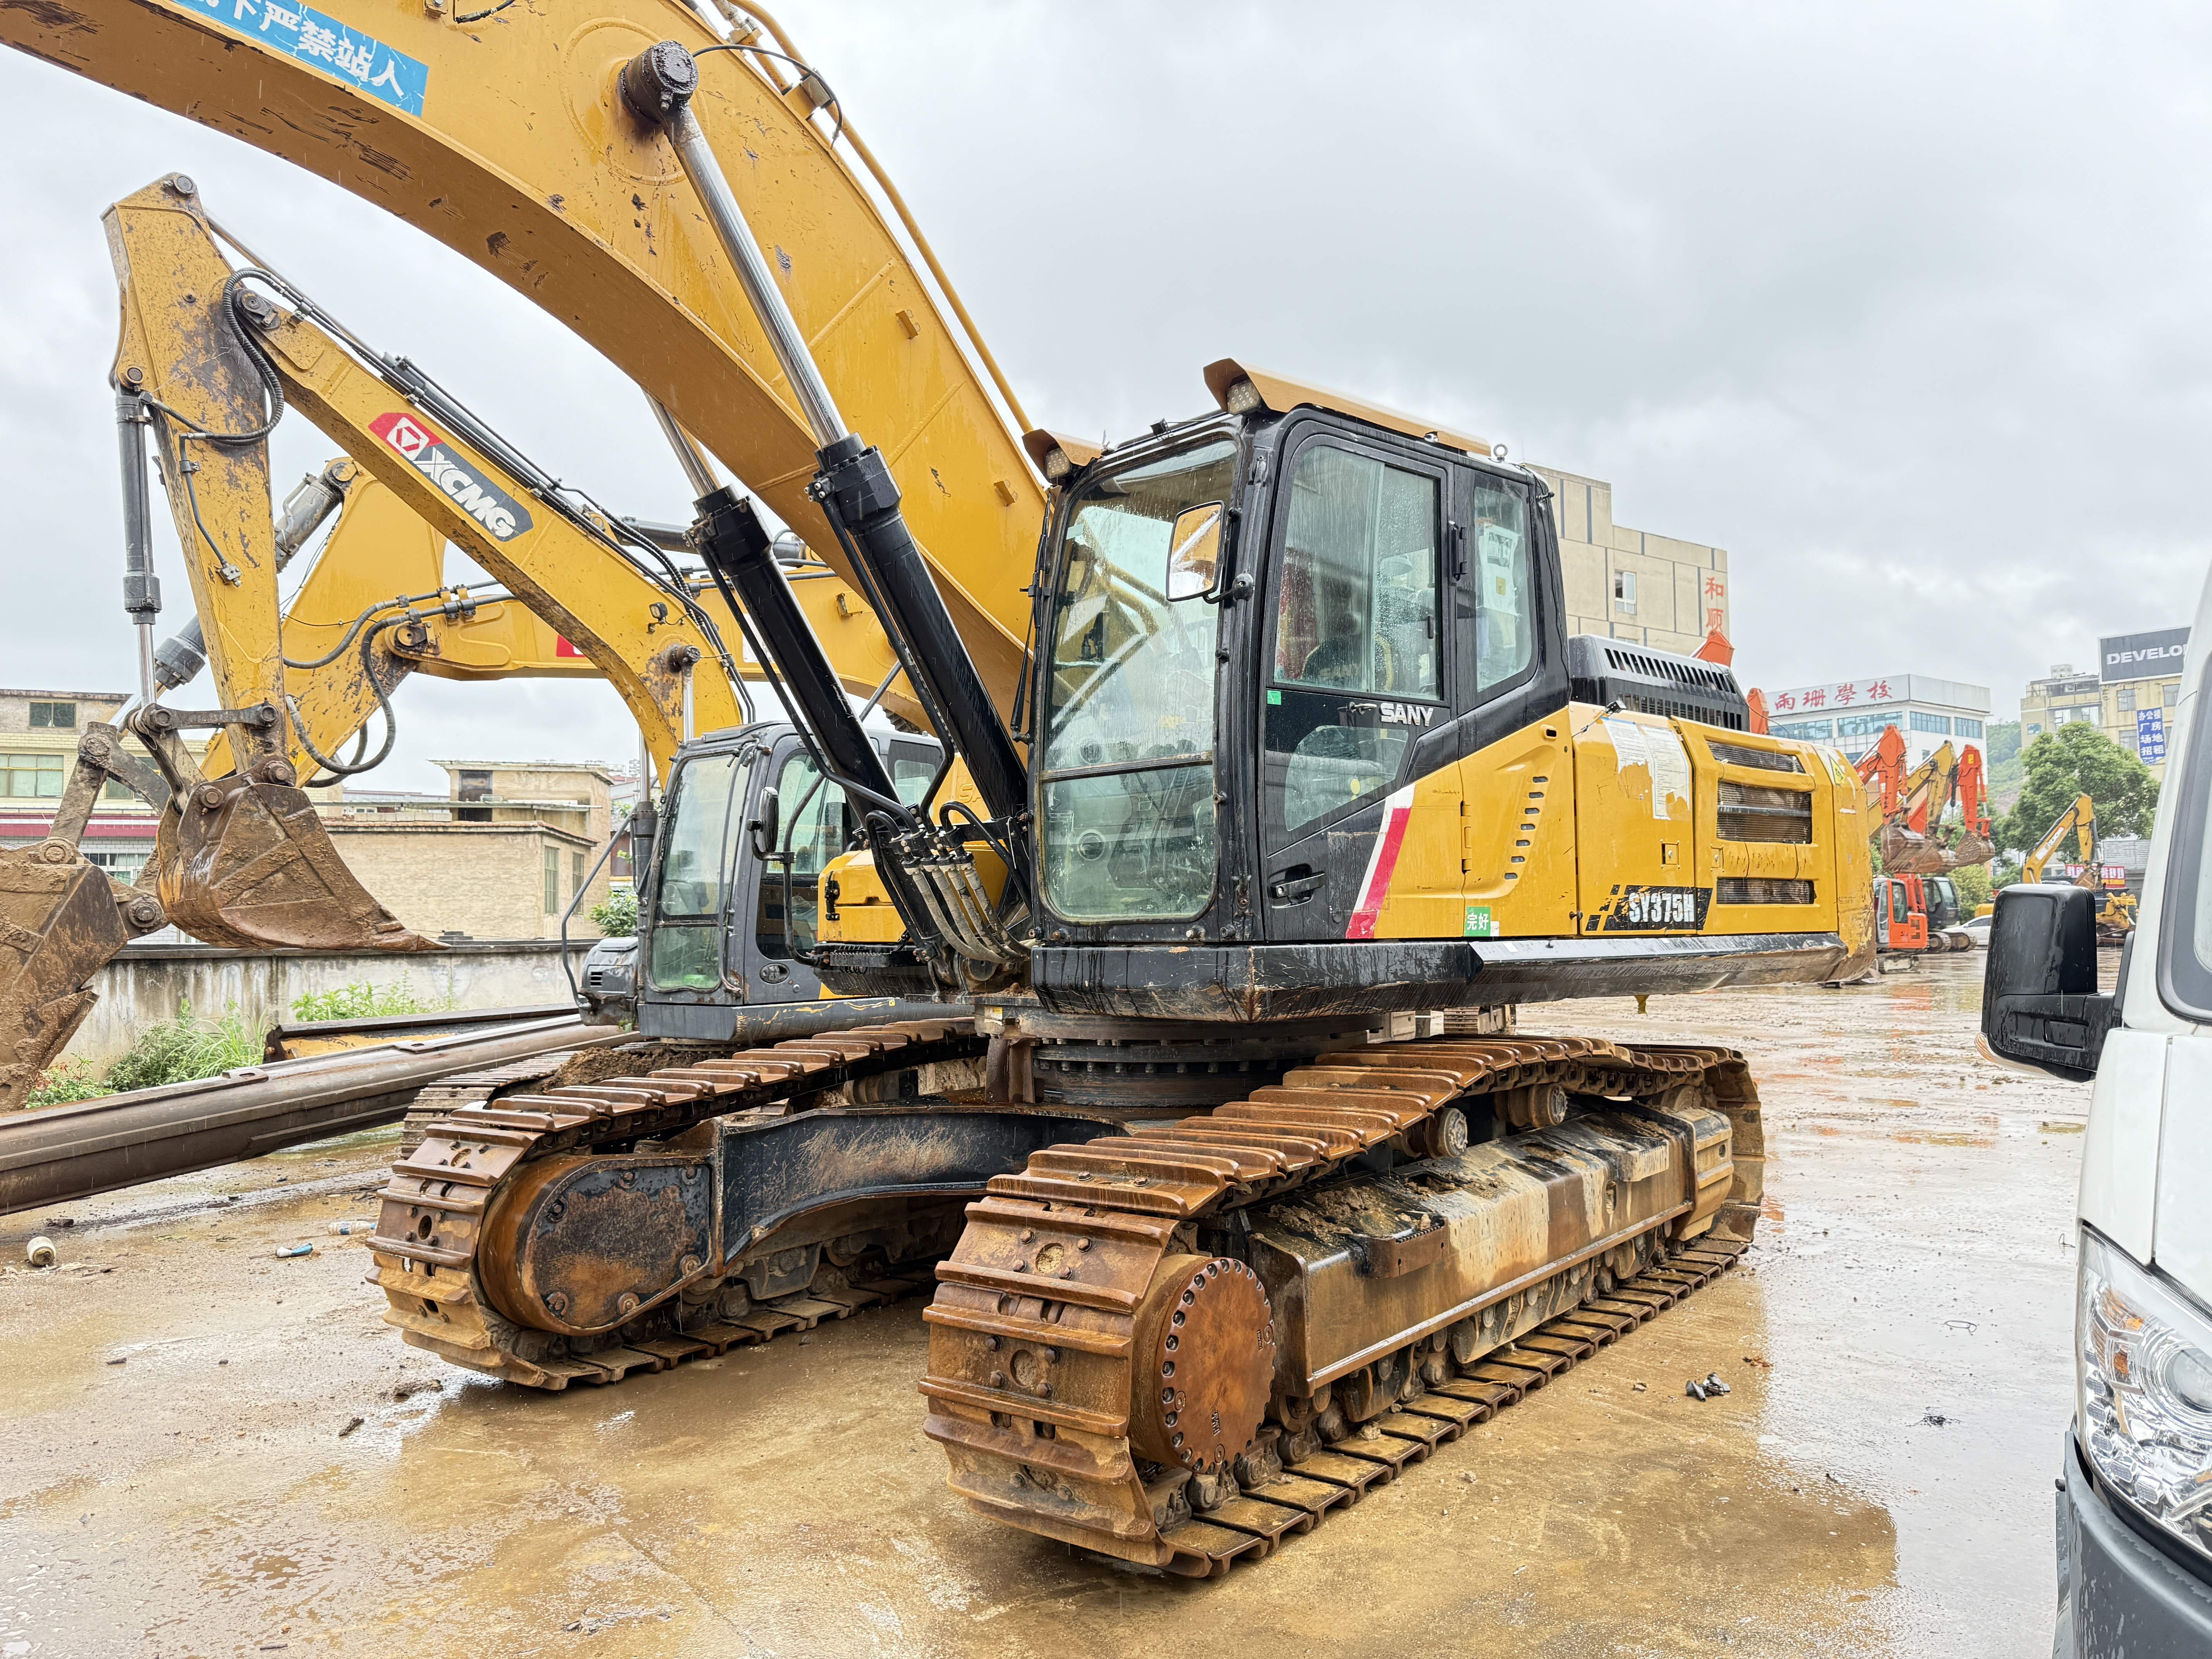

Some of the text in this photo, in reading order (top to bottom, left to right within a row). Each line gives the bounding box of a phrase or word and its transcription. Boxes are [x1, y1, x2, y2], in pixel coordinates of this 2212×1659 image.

[199, 0, 404, 100] 下严禁站人
[413, 447, 516, 537] XCMG
[1704, 577, 1724, 632] 和顺
[1380, 702, 1434, 727] SANY
[2139, 721, 2162, 732] 厂房
[2140, 733, 2164, 744] 场地
[2141, 745, 2164, 756] 招租
[1628, 892, 1695, 923] SY375H
[1467, 912, 1489, 931] 完好
